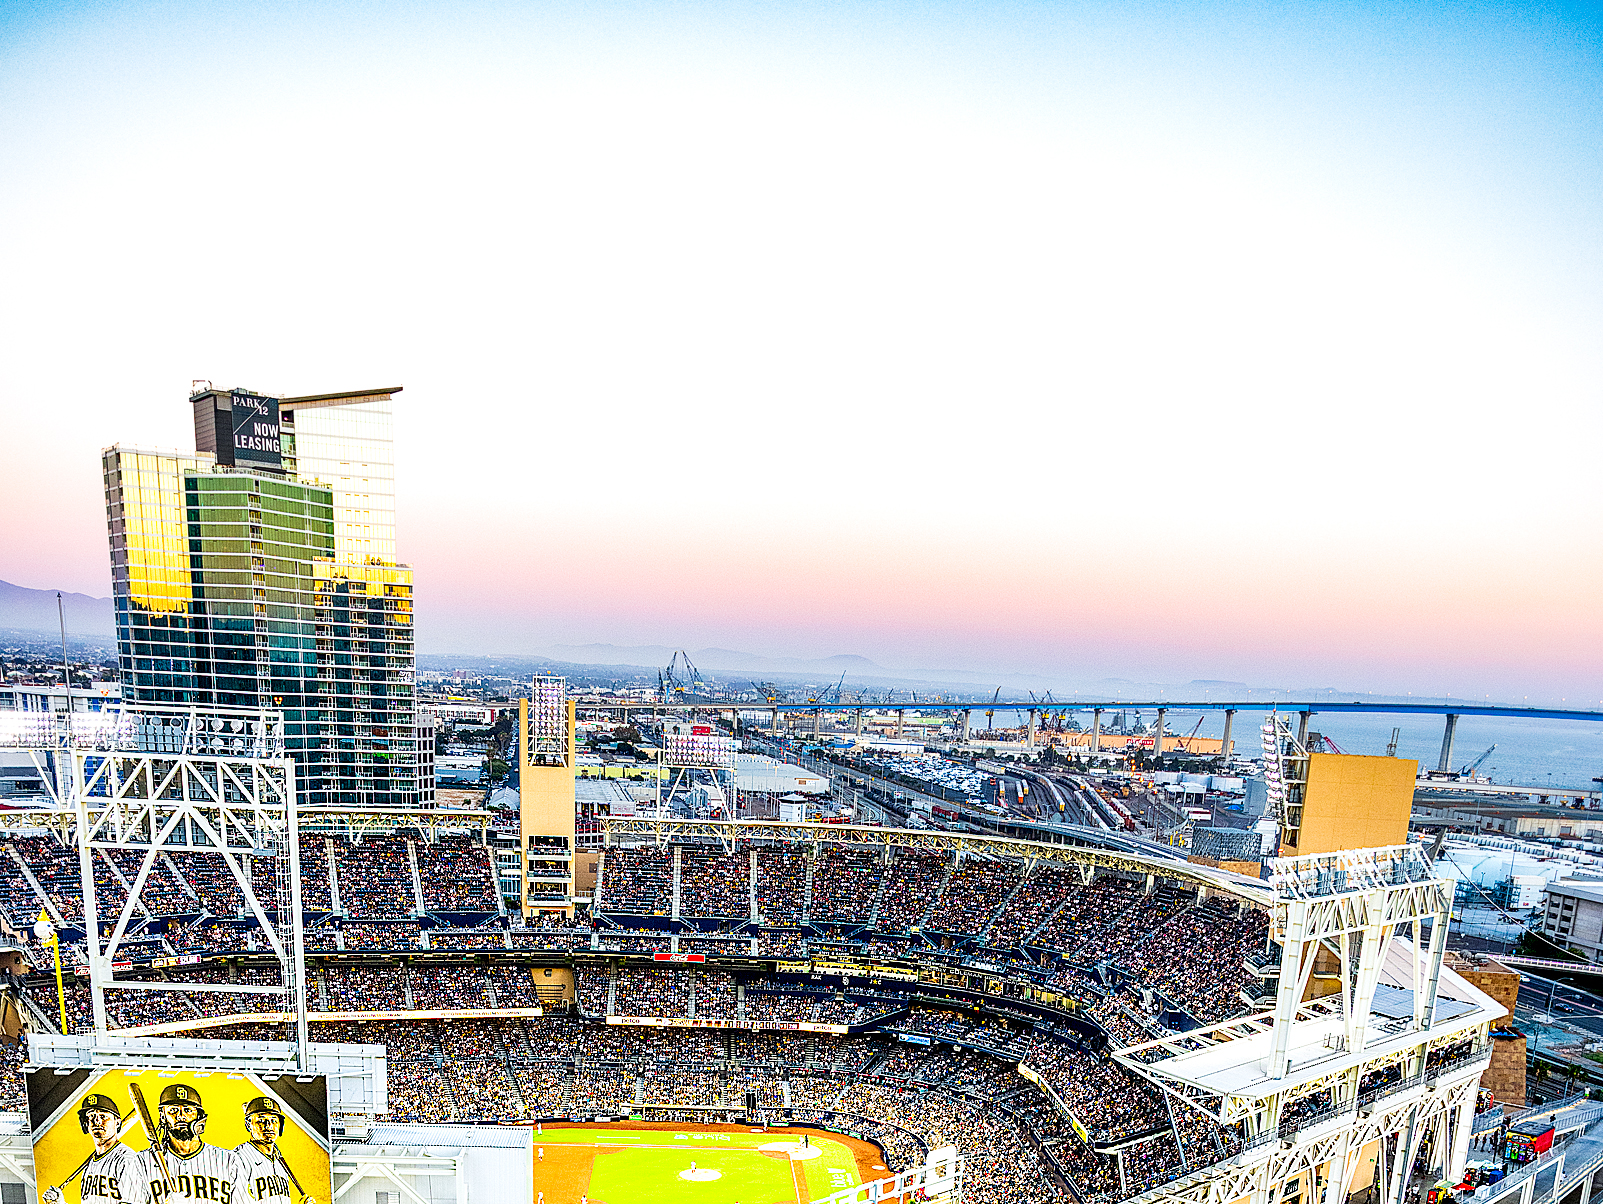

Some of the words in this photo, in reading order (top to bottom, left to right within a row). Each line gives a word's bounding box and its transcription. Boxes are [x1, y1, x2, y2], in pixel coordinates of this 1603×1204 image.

[233, 396, 260, 409] PARK
[258, 406, 269, 416] 12
[254, 421, 278, 438] NOW
[234, 434, 280, 453] LEASING
[81, 1175, 123, 1200] DRES
